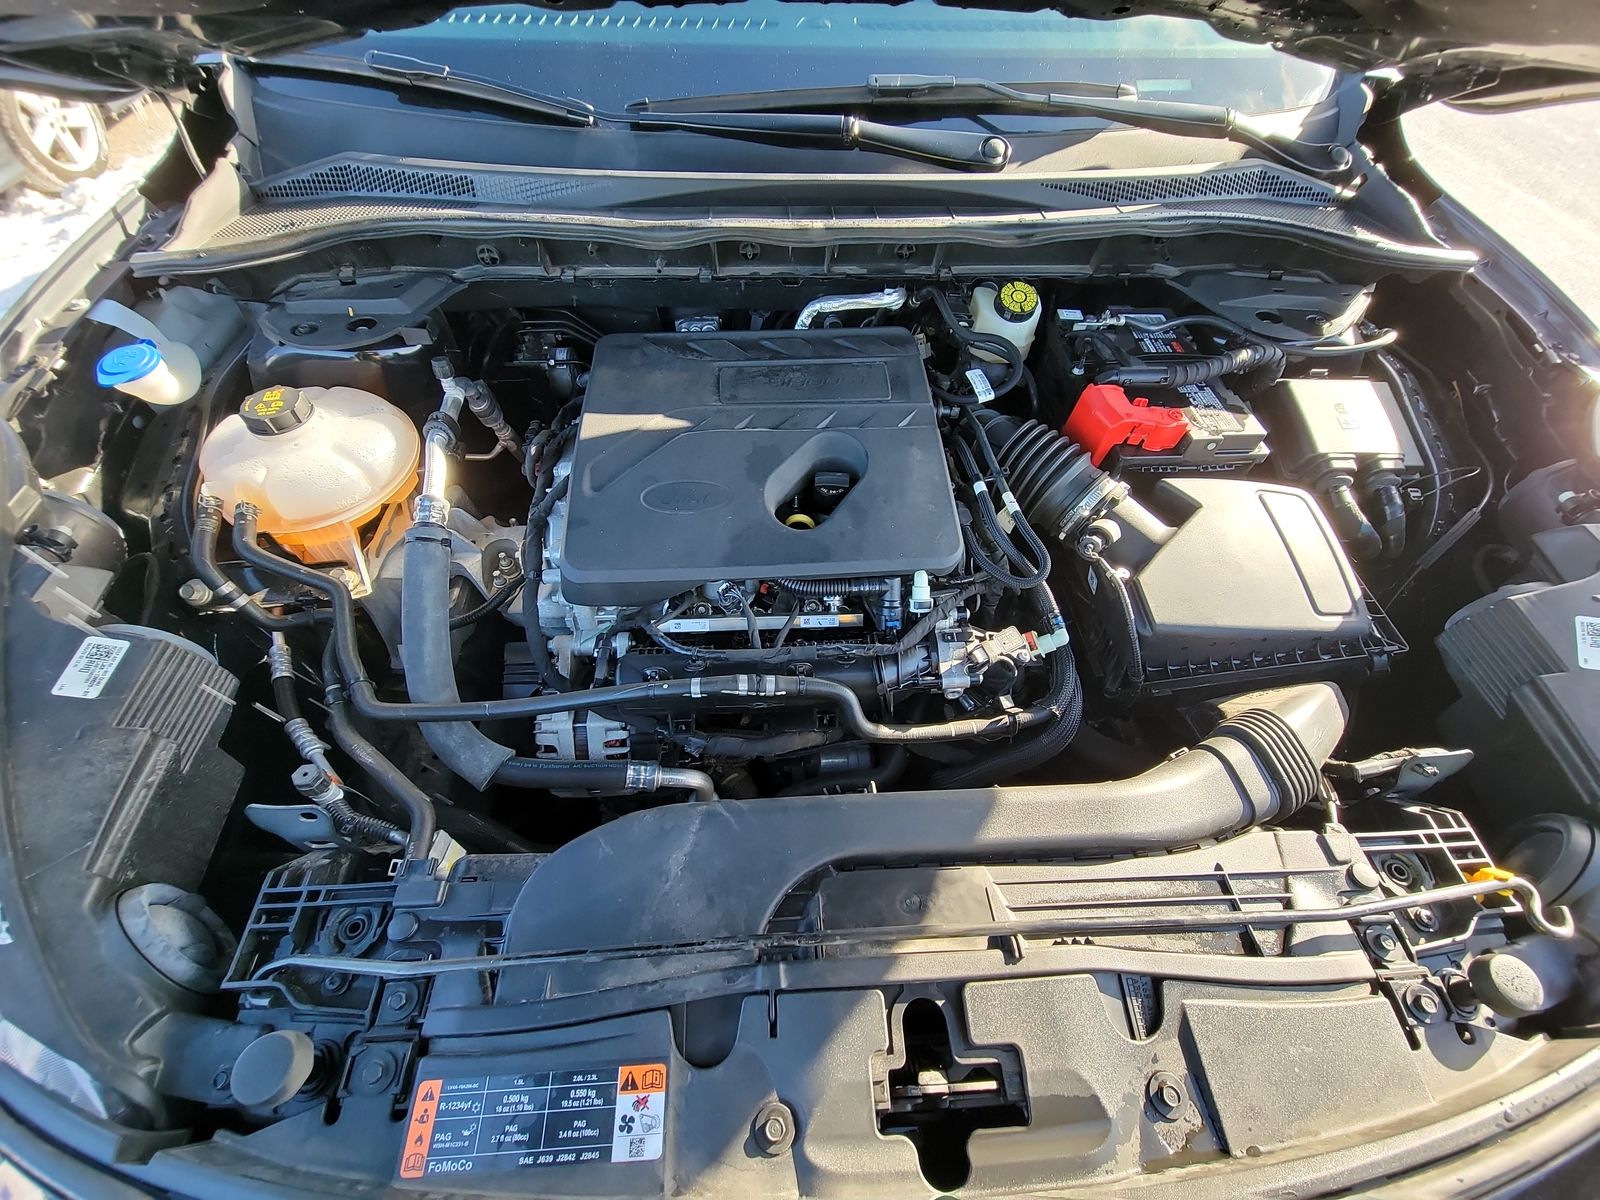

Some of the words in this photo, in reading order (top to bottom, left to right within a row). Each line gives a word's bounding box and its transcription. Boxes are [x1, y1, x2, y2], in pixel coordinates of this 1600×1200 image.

[502, 1095, 520, 1104] 0.500
[520, 1093, 530, 1103] kg
[570, 1089, 587, 1099] 0.550
[587, 1088, 596, 1098] kg
[439, 1100, 472, 1112] R-1234yf
[504, 1124, 518, 1133] PAG
[573, 1120, 587, 1128] PAG
[434, 1132, 452, 1142] PAG
[558, 1130, 568, 1139] 3.4
[518, 1156, 534, 1165] SAE
[536, 1154, 554, 1164] J639
[555, 1152, 577, 1162] J2842
[427, 1159, 473, 1173] FoMoCo
